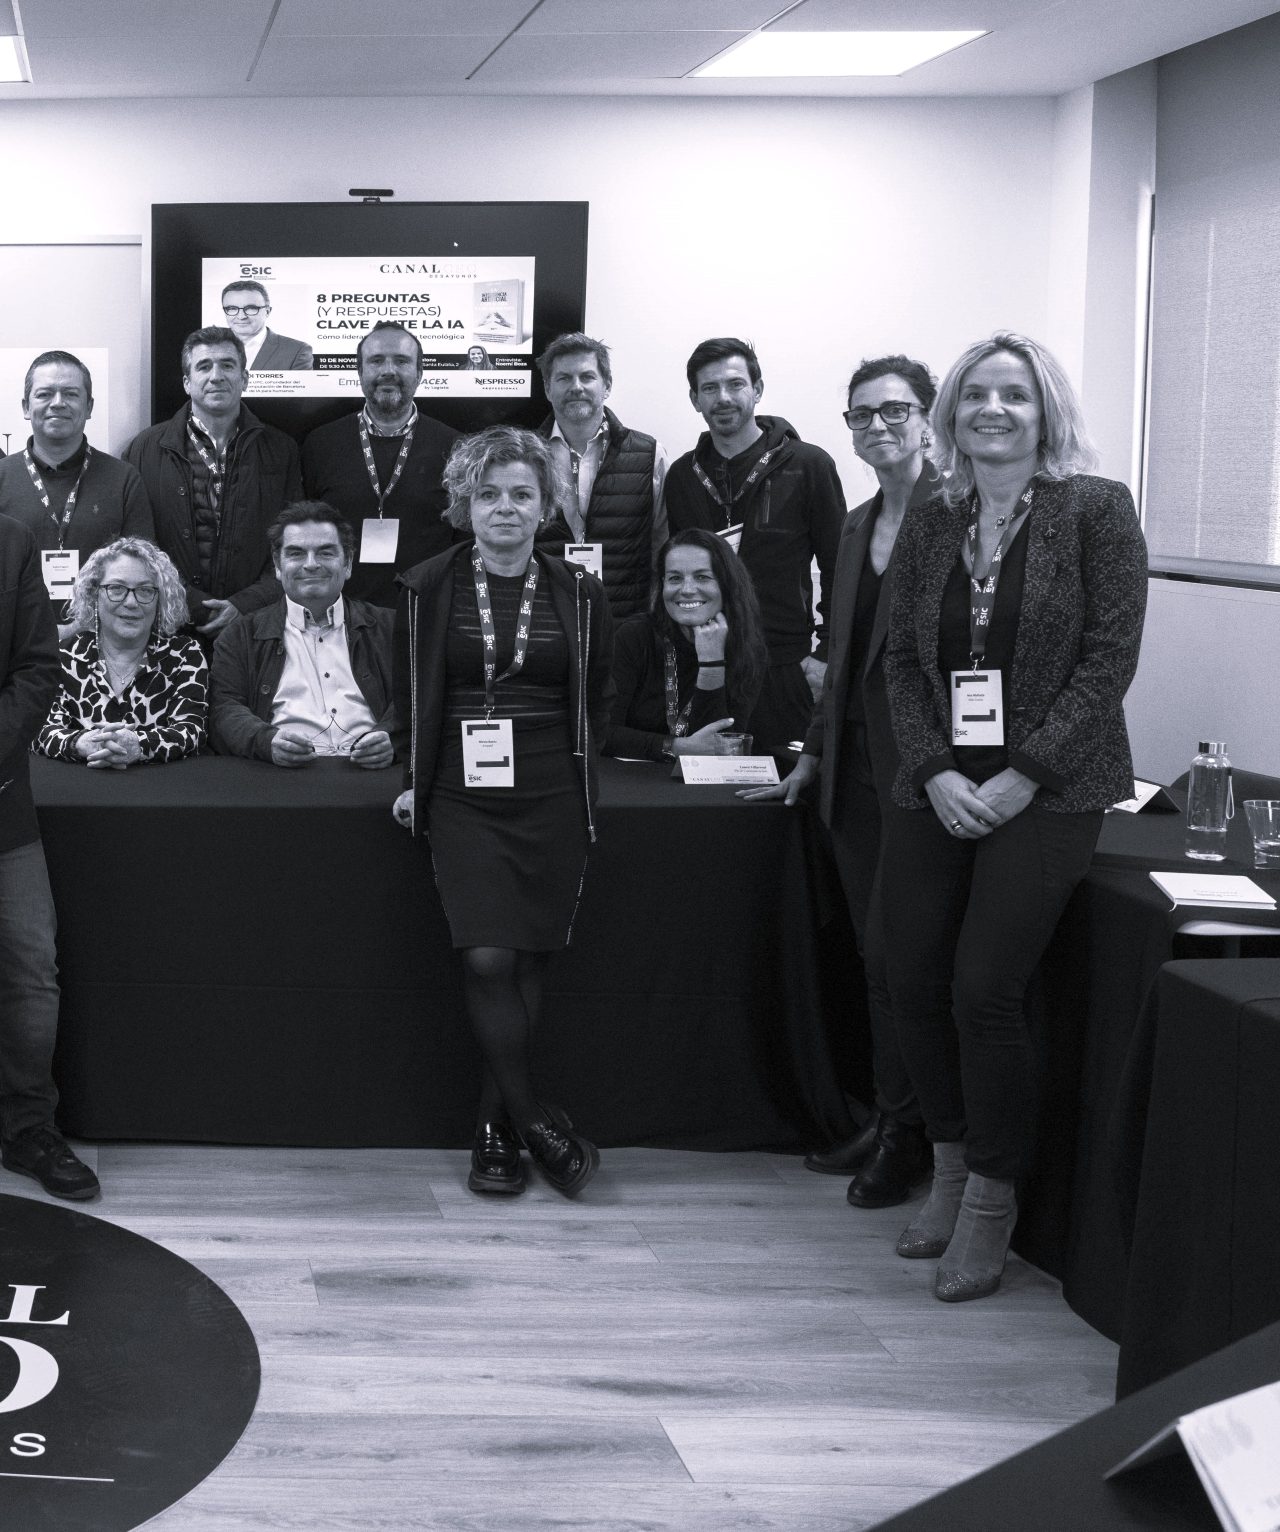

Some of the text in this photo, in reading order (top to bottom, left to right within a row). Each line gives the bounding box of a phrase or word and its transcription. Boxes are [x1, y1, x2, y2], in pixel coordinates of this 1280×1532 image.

[380, 264, 441, 274] CANAL
[316, 294, 430, 303] 8 PREGUNTAS
[317, 306, 442, 317] (Y RESPUESTAS)
[316, 320, 370, 329] CLAVE
[422, 320, 444, 329] LA
[448, 320, 464, 329] IA
[475, 377, 526, 385] NESPRESSO
[1022, 488, 1034, 506] esic
[992, 544, 1002, 562] esic
[473, 557, 482, 572] esic
[476, 582, 486, 598] esic
[526, 574, 536, 590] esic
[983, 576, 996, 594] esic
[480, 608, 490, 624] esic
[520, 600, 530, 616] esic
[976, 607, 989, 626] esic
[517, 625, 528, 640] esic
[484, 634, 494, 650] esic
[514, 650, 524, 666] esic
[485, 664, 495, 680] esic
